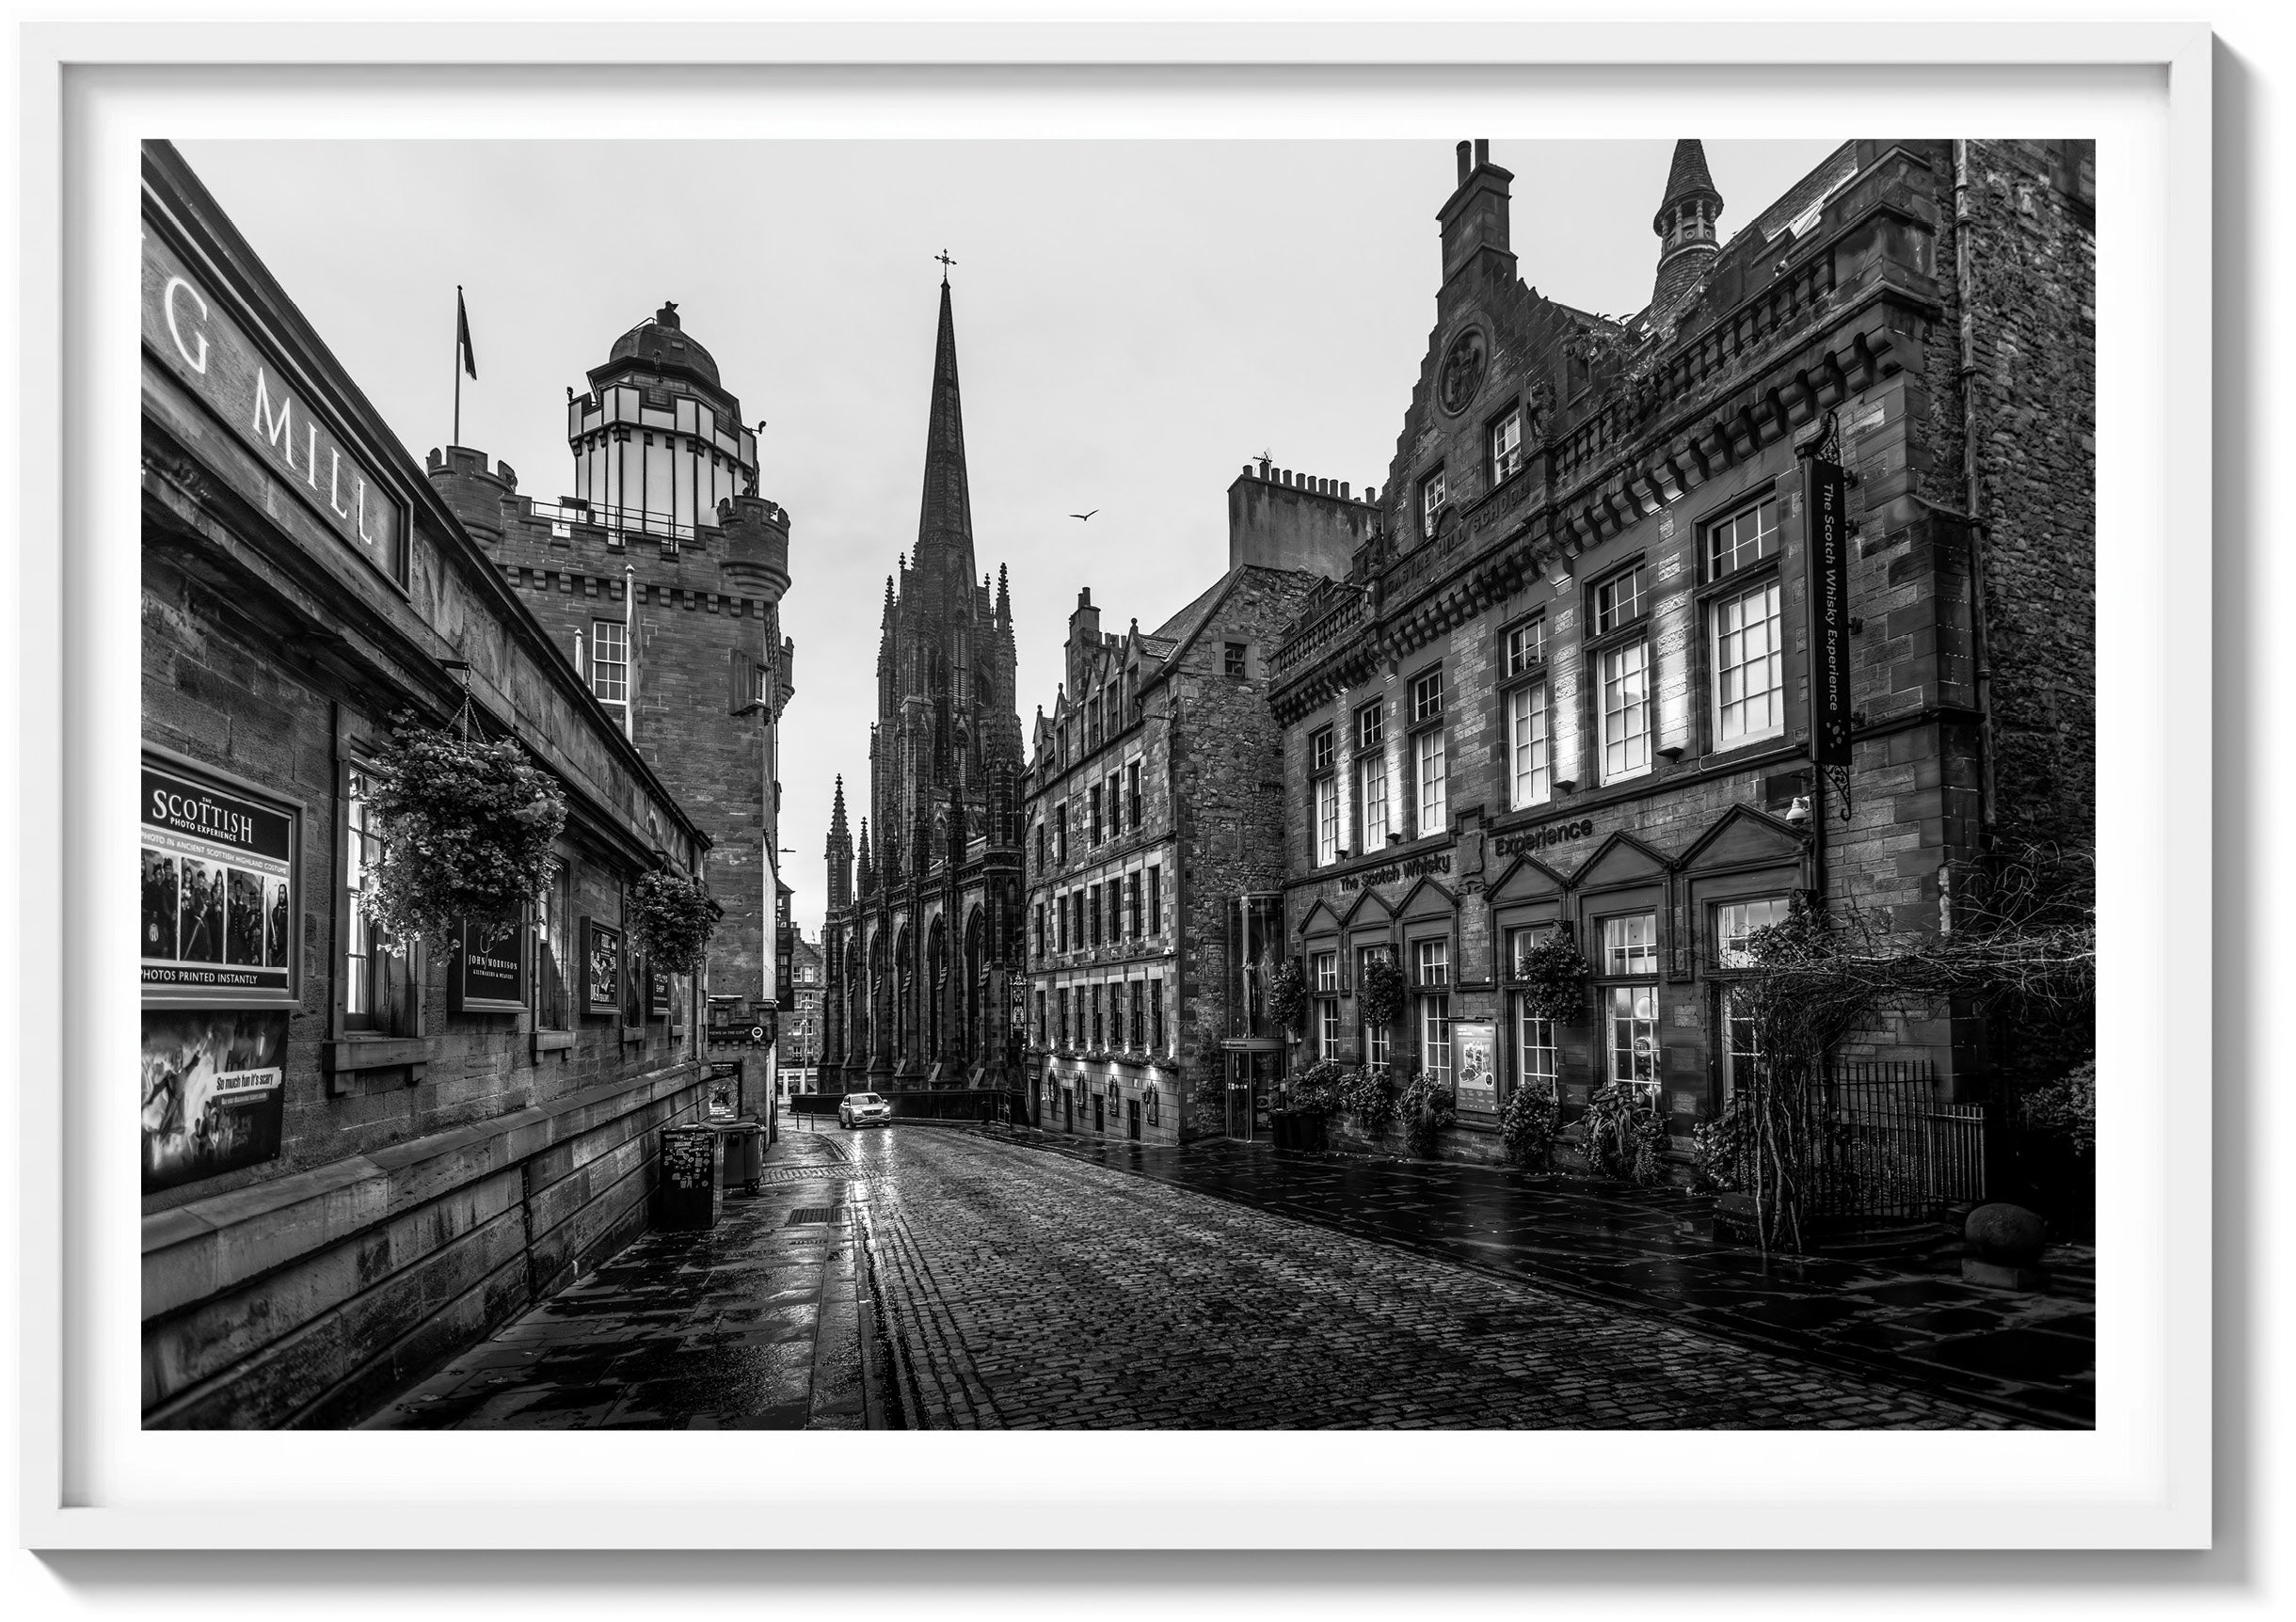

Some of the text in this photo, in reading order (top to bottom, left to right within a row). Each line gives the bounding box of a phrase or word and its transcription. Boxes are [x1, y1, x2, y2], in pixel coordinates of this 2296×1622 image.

[253, 366, 373, 546] MILL
[1438, 529, 1466, 559] HILL
[1472, 478, 1531, 533] SCHOOL
[1823, 483, 1839, 711] The Scotch Whisky Experience
[152, 789, 253, 844] SCOTTISH
[201, 796, 213, 804] THE
[170, 817, 237, 843] PHOTO EXPERIENCE
[167, 838, 176, 848] IN
[176, 840, 205, 854] ANCIENT
[206, 848, 235, 862] SCOTTISH
[235, 856, 263, 868] HIGHLAND
[263, 862, 287, 875] COSTUME
[1340, 818, 1593, 891] The Scotch Whisky Experience
[179, 971, 215, 982] PRINTED
[217, 973, 258, 984] INSTANTLY
[469, 954, 518, 970] JOHN MORRISON
[216, 1073, 274, 1091] So much fun it's scary
